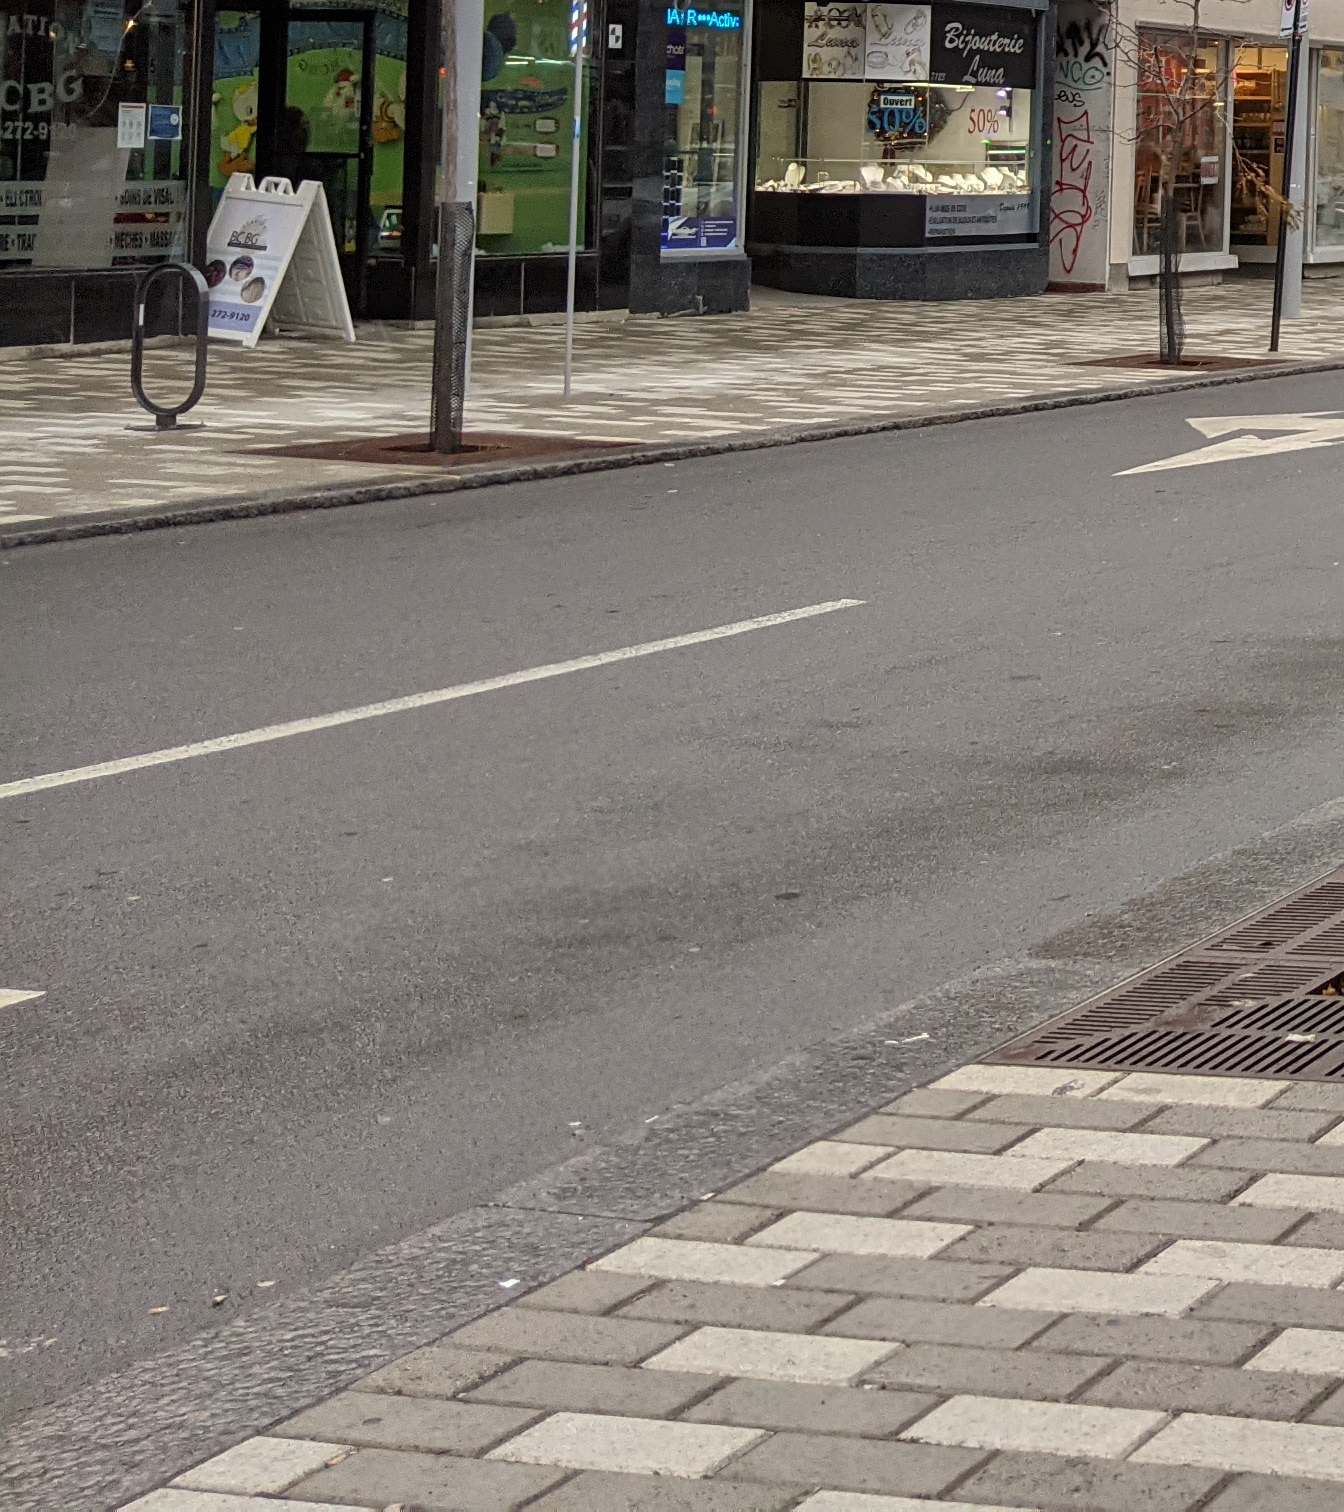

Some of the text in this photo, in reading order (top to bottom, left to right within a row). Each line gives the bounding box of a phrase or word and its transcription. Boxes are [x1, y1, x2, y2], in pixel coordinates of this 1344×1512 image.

[944, 22, 1025, 56] Bijouterie
[962, 55, 1006, 85] Luna
[883, 97, 915, 108] Ouvert
[867, 105, 927, 134] 50%
[967, 108, 1000, 134] 50%
